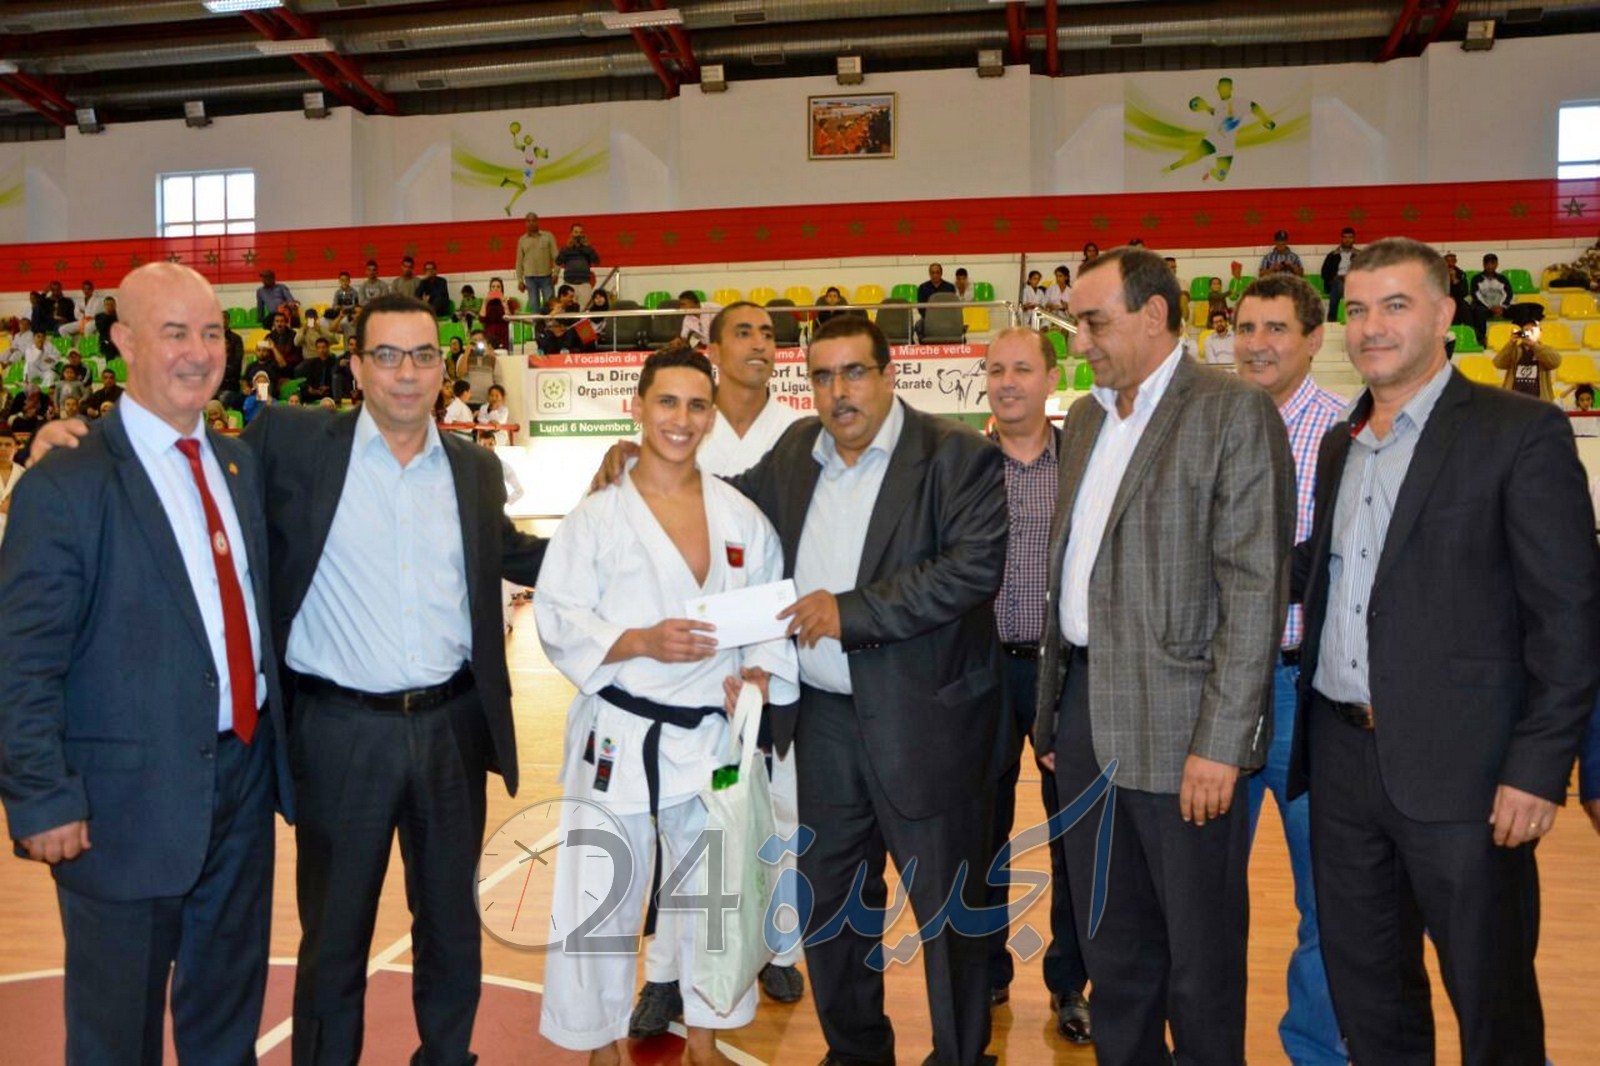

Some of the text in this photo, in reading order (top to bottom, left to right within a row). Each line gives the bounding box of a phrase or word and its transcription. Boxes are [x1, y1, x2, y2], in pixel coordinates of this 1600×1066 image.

[624, 353, 637, 362] de
[899, 345, 940, 355] Marche
[942, 345, 971, 355] verte
[587, 370, 604, 382] La
[609, 370, 640, 382] Dire
[771, 366, 791, 378] orf
[578, 385, 638, 399] Organisent
[539, 423, 568, 433] Lundi
[570, 423, 577, 432] 6
[579, 422, 631, 432] Novembre
